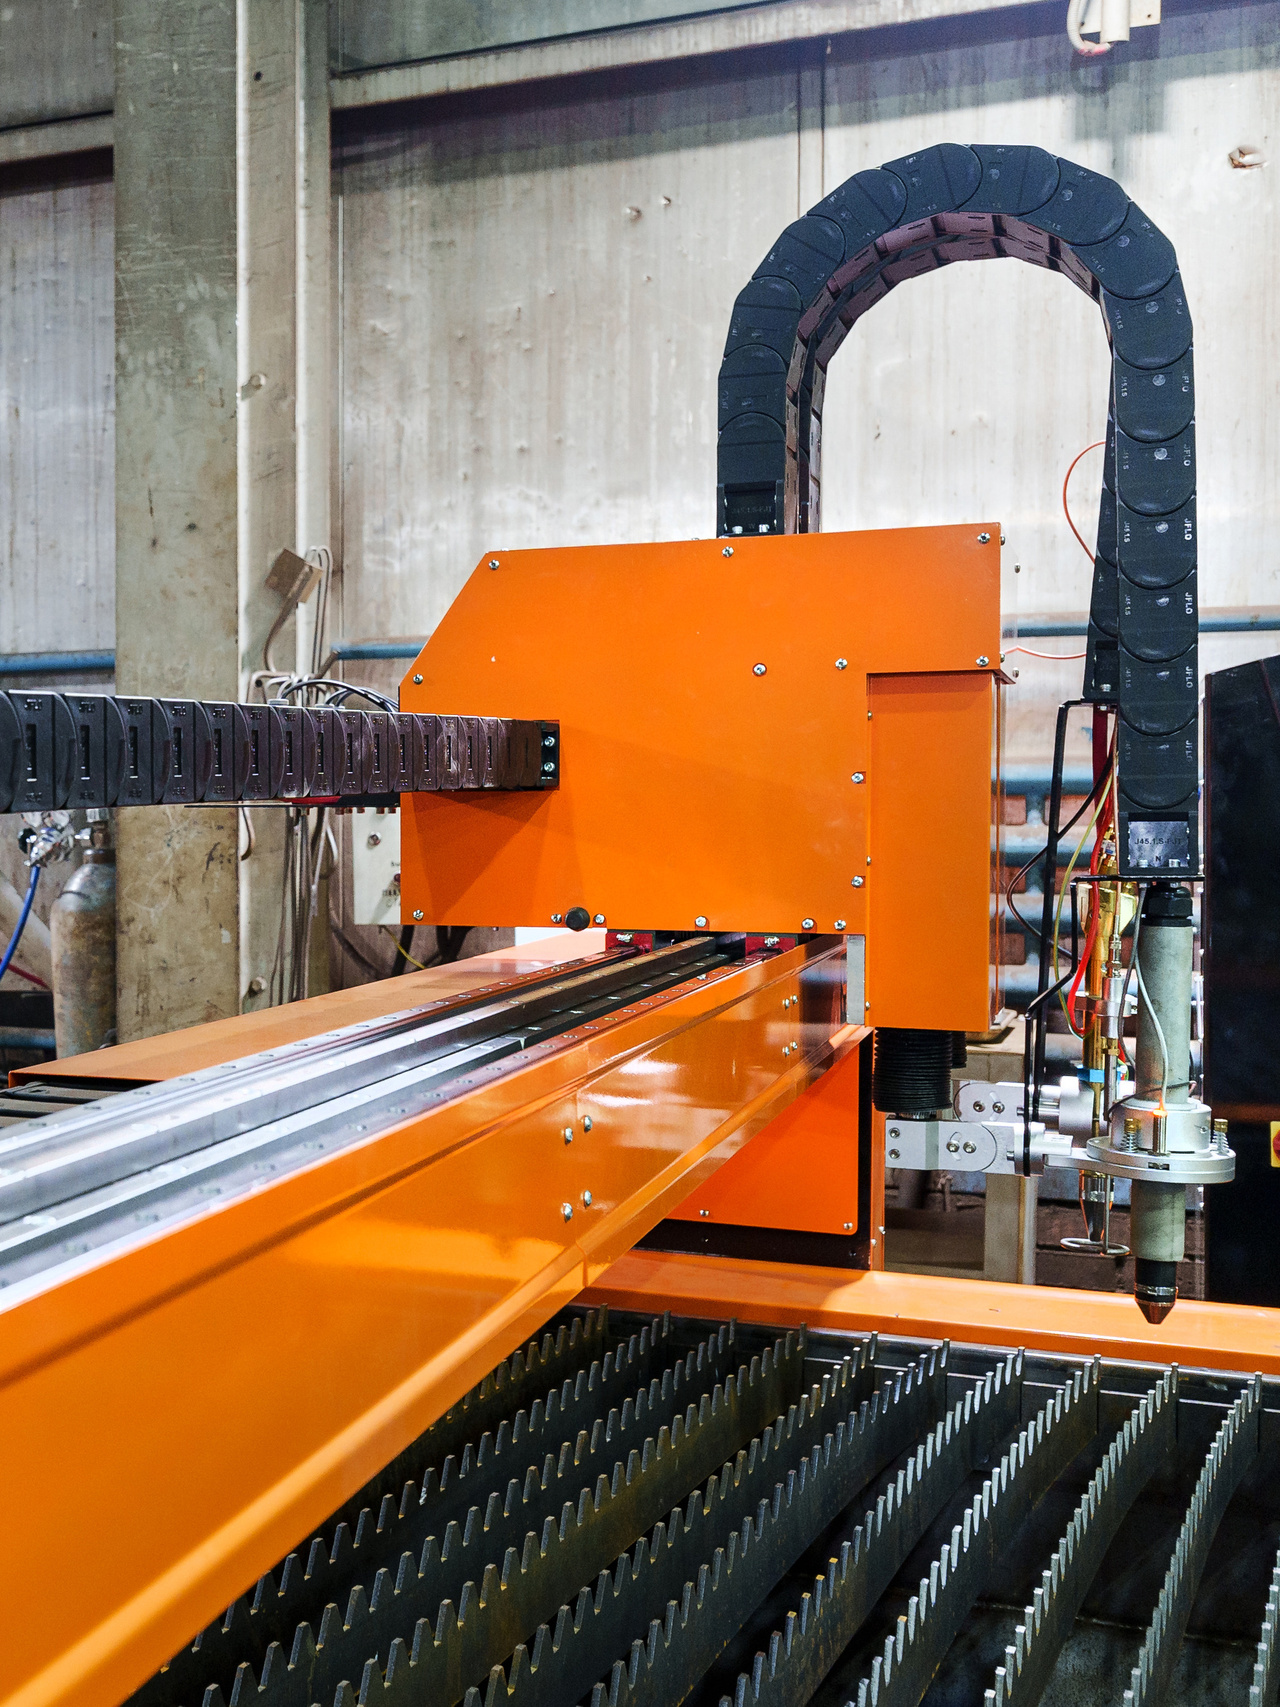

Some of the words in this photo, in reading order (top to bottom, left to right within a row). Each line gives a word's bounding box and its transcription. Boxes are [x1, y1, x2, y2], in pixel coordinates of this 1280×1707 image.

[1184, 517, 1192, 541] JFLO
[1184, 591, 1193, 615] JFLO
[1185, 665, 1193, 689] JFLO
